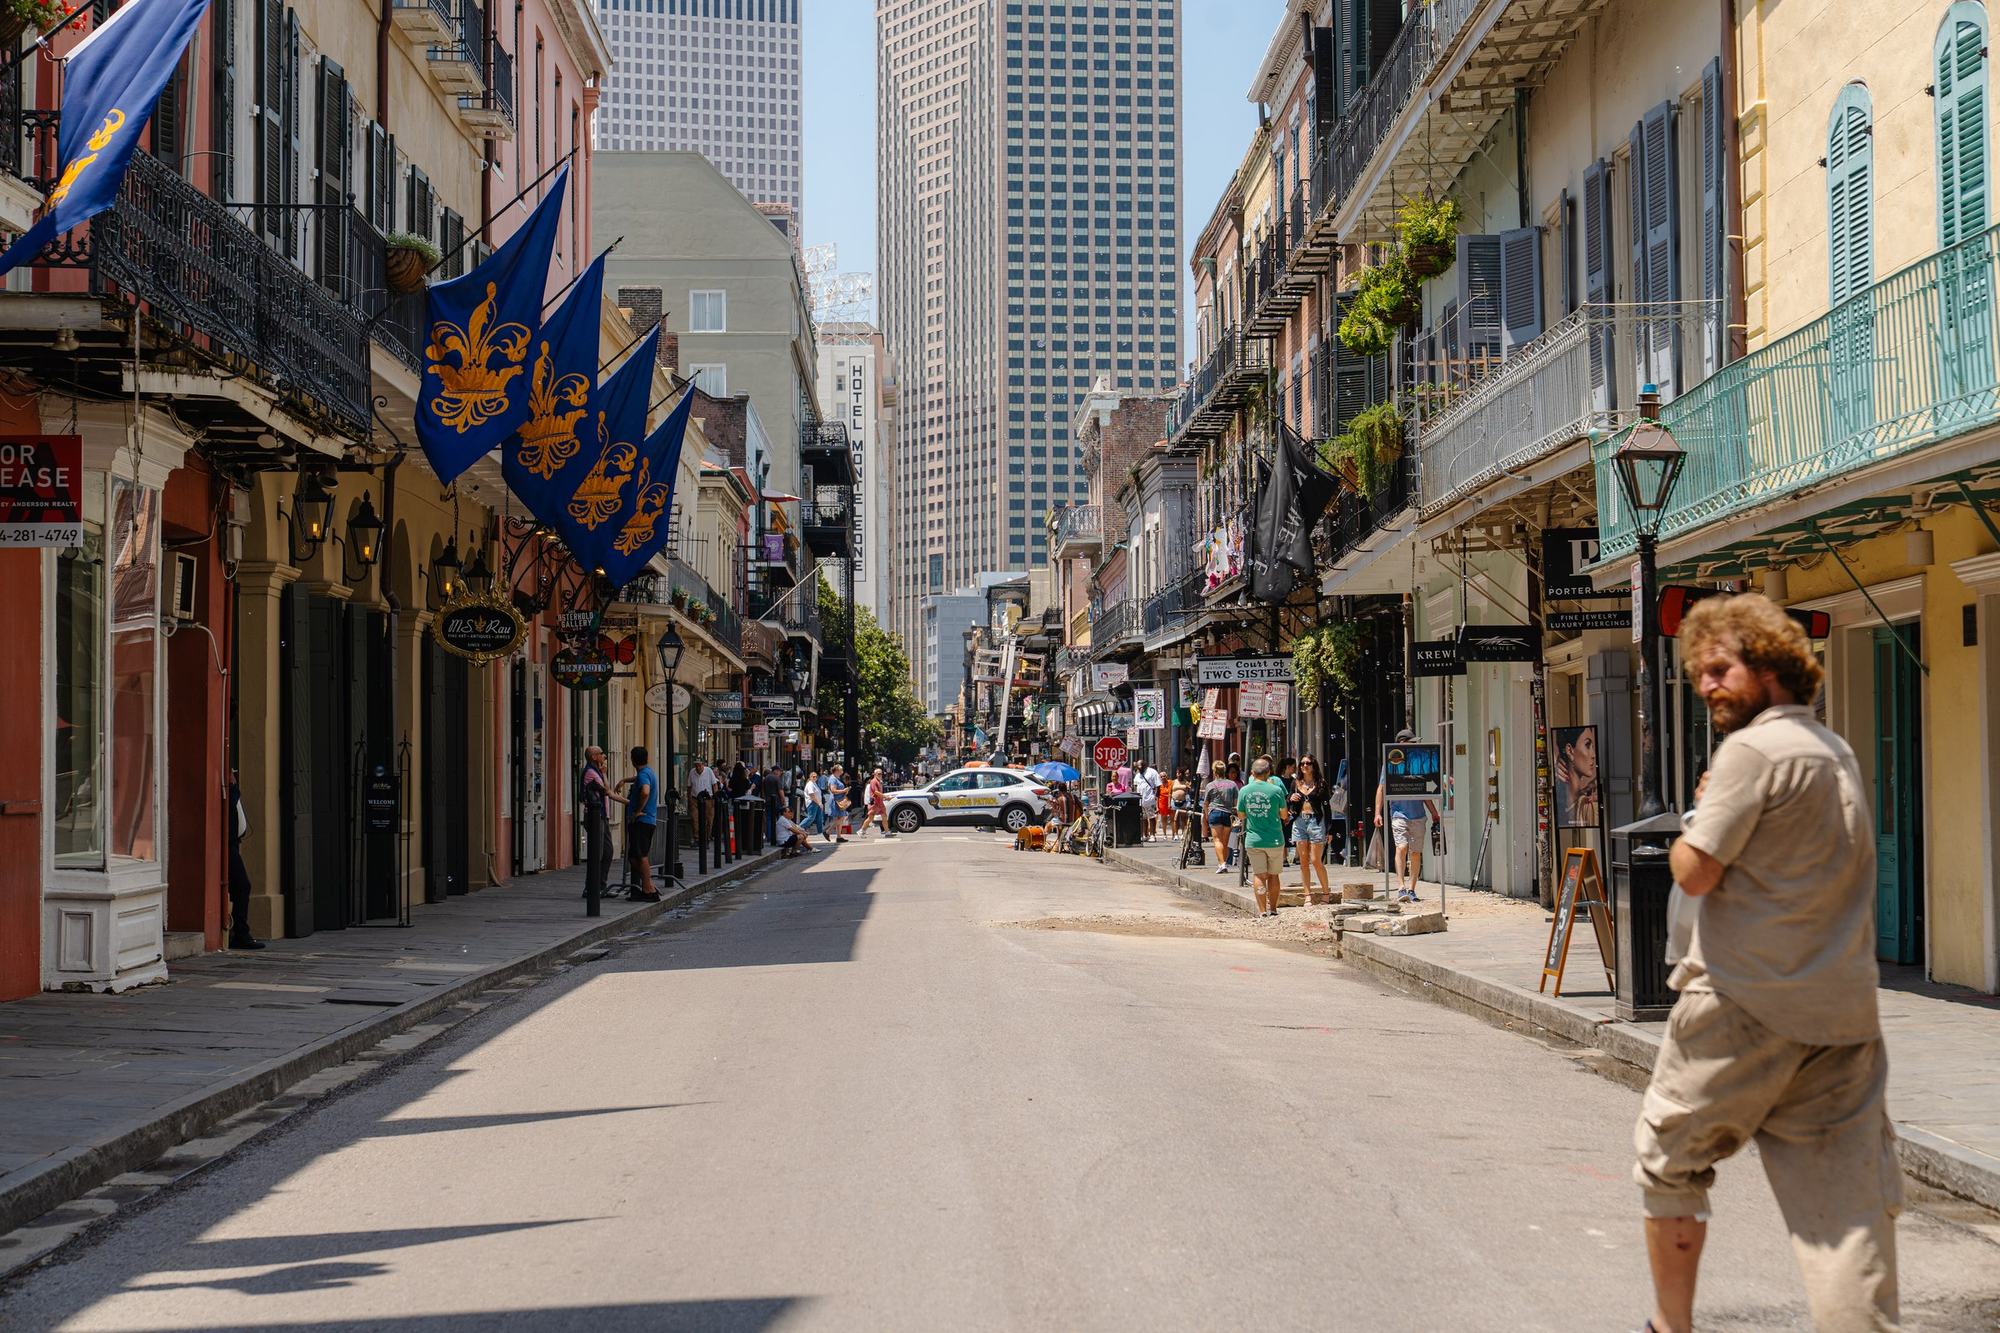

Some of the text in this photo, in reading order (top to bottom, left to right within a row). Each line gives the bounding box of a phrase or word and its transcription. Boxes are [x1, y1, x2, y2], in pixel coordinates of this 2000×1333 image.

[0, 445, 35, 465] OR
[853, 365, 863, 571] HOTEL MONTELEONE
[0, 467, 69, 488] EASE
[0, 529, 78, 542] 4-281-4749
[1548, 587, 1592, 596] PORTER
[485, 619, 512, 634] Rau
[561, 619, 592, 628] GALLERY
[1235, 660, 1285, 669] Court of
[1203, 668, 1291, 680] TWO SISTERS
[1096, 747, 1126, 760] STOP
